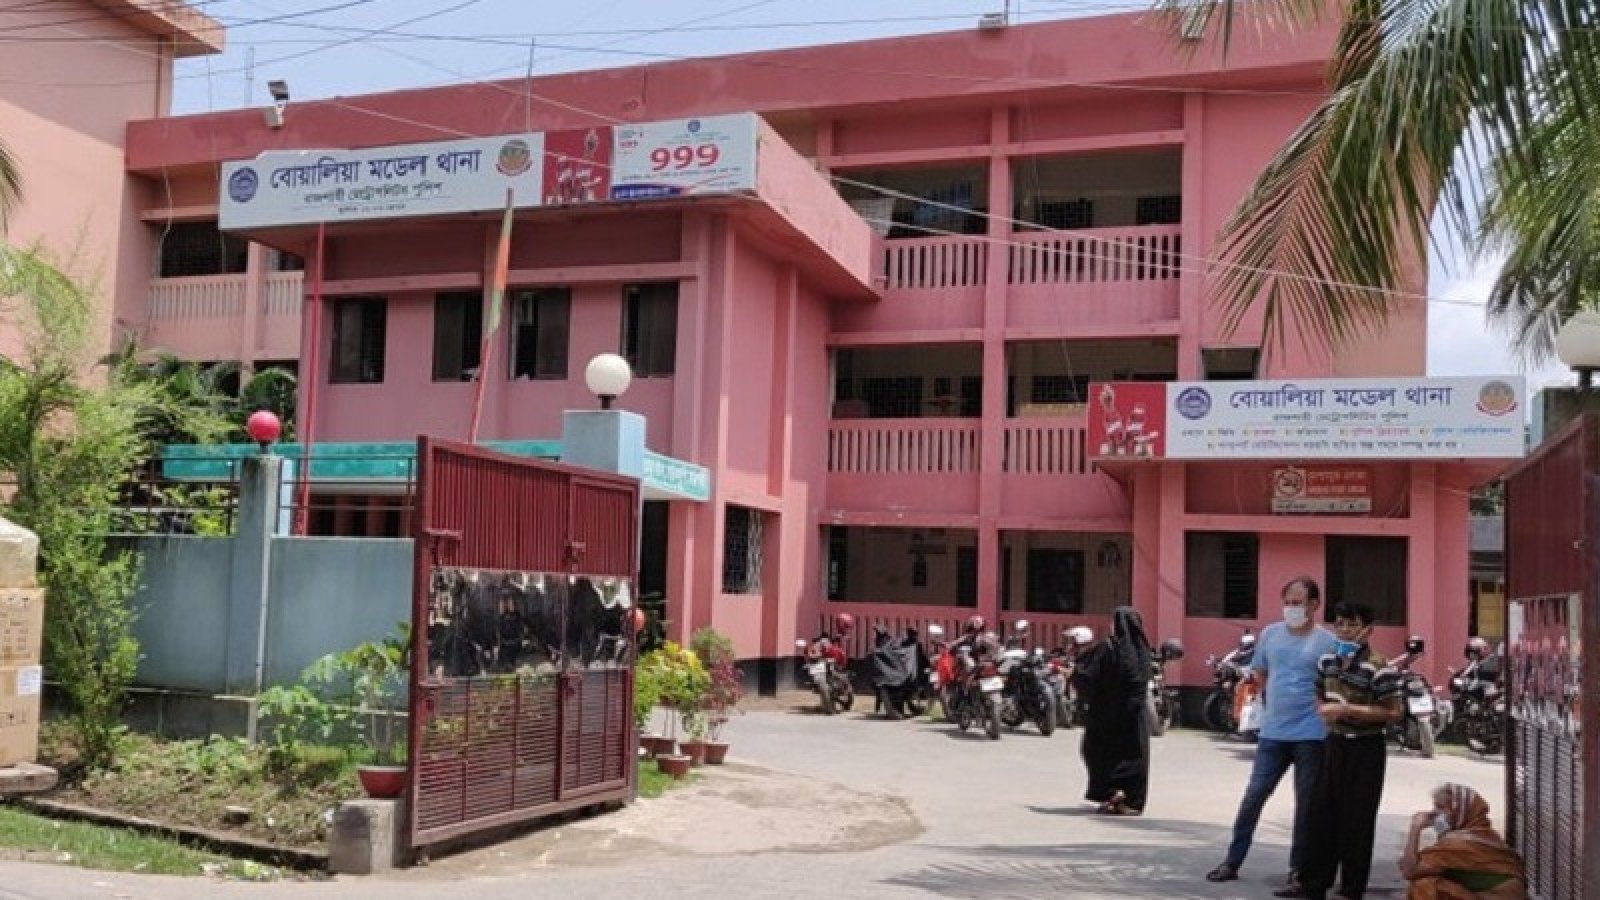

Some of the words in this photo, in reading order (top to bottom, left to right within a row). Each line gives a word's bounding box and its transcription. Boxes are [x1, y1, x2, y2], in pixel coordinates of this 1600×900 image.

[270, 156, 362, 189] বোয়ালিয়া
[368, 154, 429, 181] মডেল
[436, 149, 482, 175] থানা
[650, 143, 719, 171] 999
[1230, 384, 1325, 408] বোয়ালিয়া
[1332, 387, 1396, 407] মডেল
[1404, 385, 1453, 406] থানা
